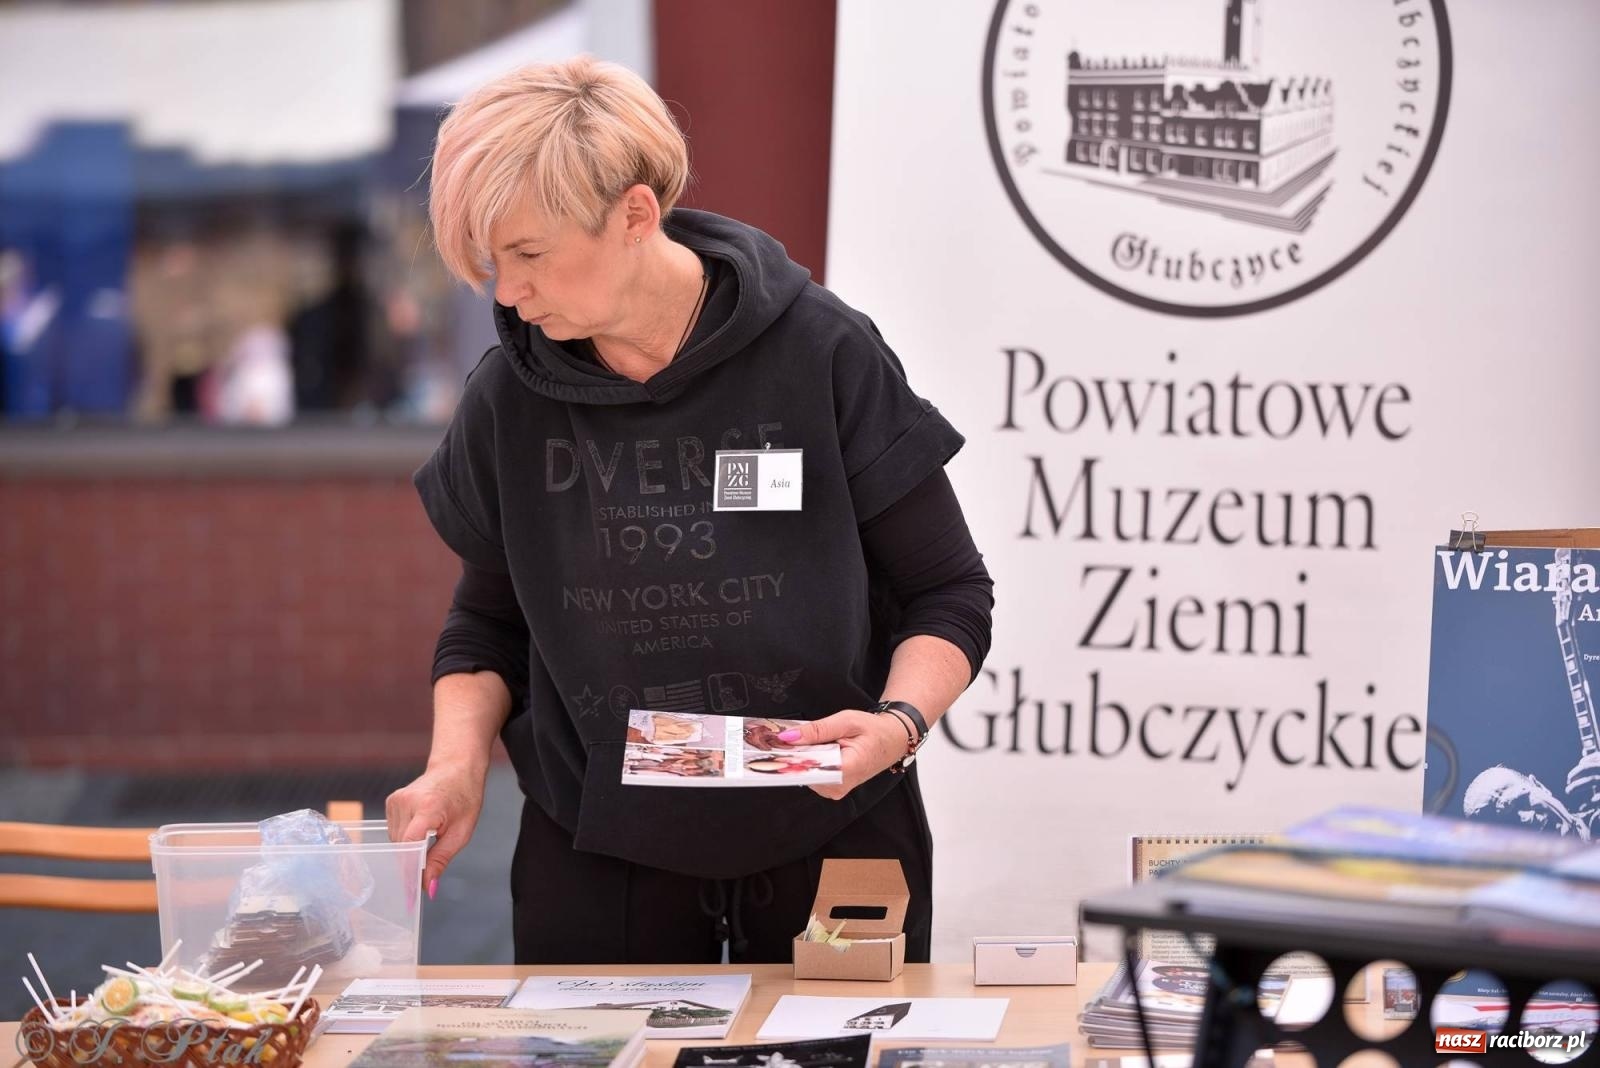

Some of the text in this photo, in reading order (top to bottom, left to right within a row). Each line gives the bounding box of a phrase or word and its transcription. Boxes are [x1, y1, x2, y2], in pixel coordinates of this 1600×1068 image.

[996, 347, 1413, 441] Powiatowe
[770, 478, 791, 489] Asia
[1017, 454, 1380, 550] Muzeum
[593, 503, 696, 521] STABLISHED
[600, 520, 718, 565] 1993
[562, 572, 785, 613] NEW YORK CITY
[1076, 562, 1312, 658] Ziemi
[659, 613, 721, 631] STATES
[726, 610, 752, 626] OF
[632, 635, 714, 655] AMERICA
